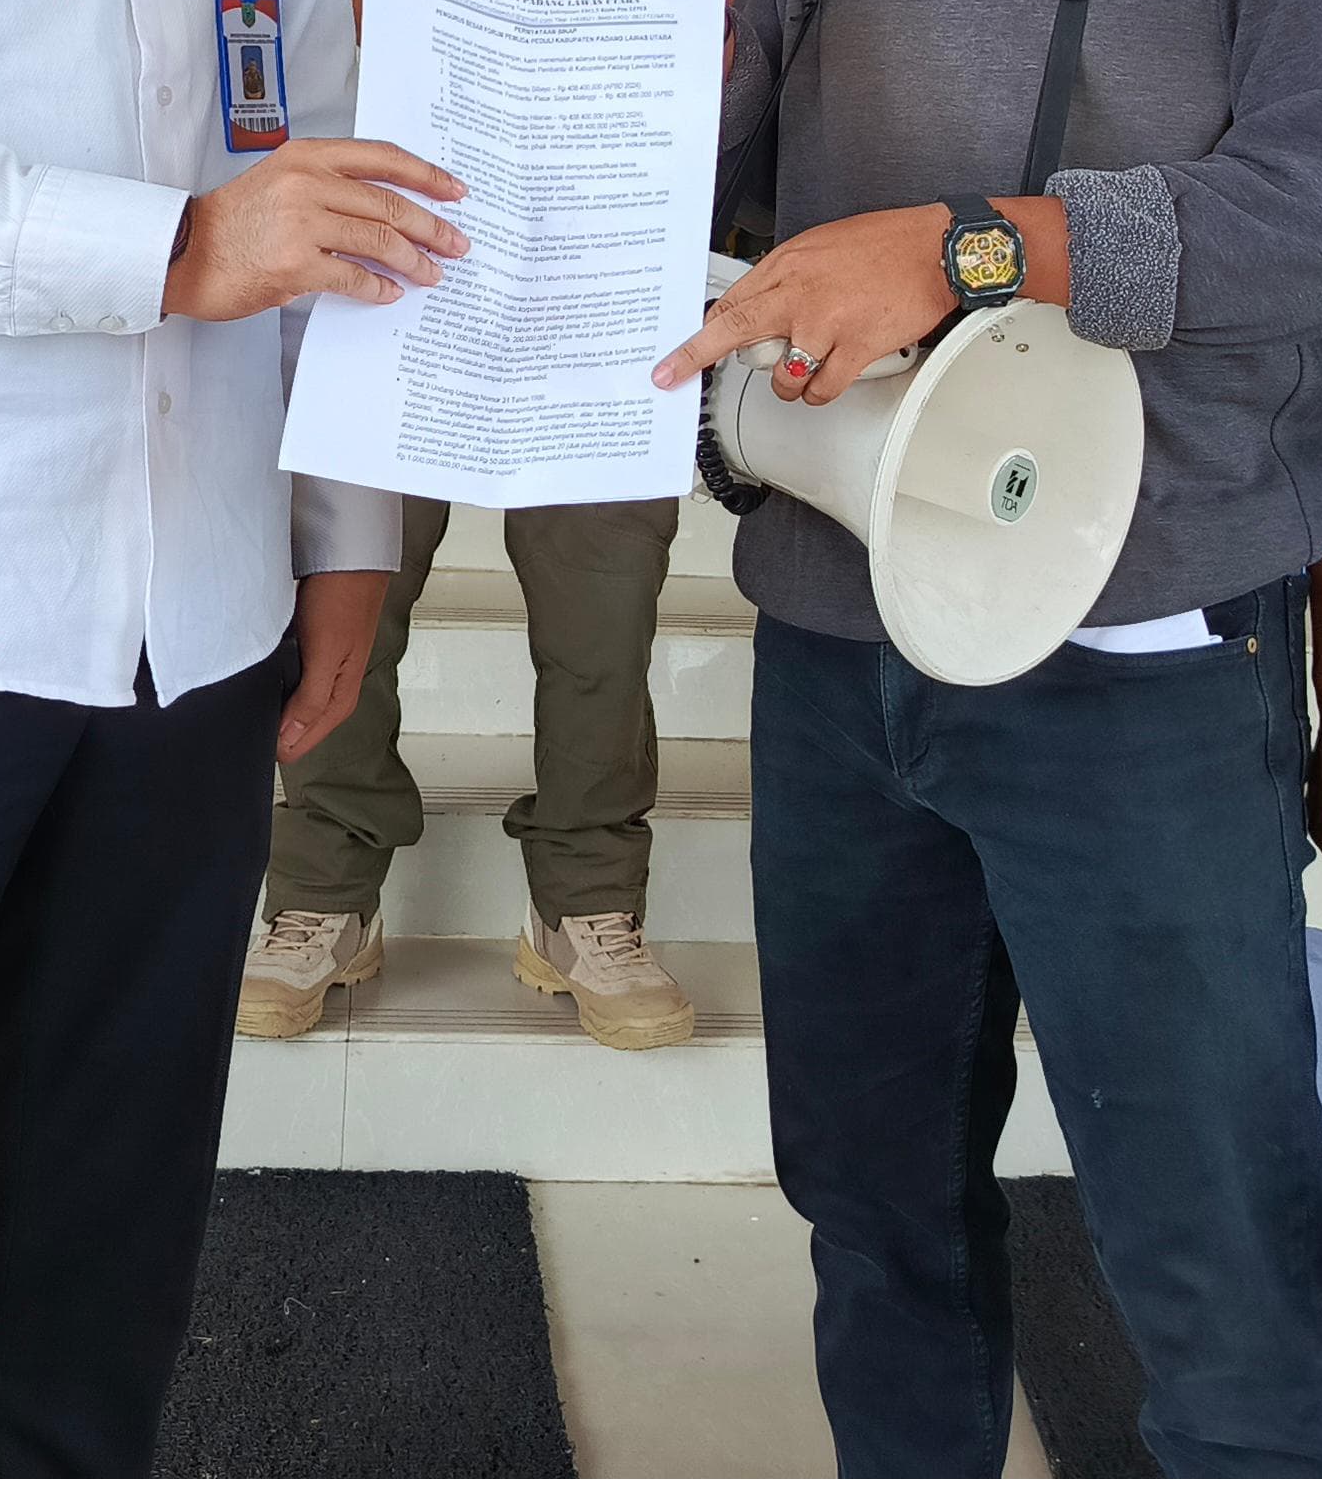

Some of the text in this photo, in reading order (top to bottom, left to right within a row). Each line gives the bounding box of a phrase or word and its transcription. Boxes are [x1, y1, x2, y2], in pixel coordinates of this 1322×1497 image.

[567, 0, 603, 7] LAWAS
[555, 35, 594, 44] KABUPATEN
[596, 34, 623, 42] PADANG
